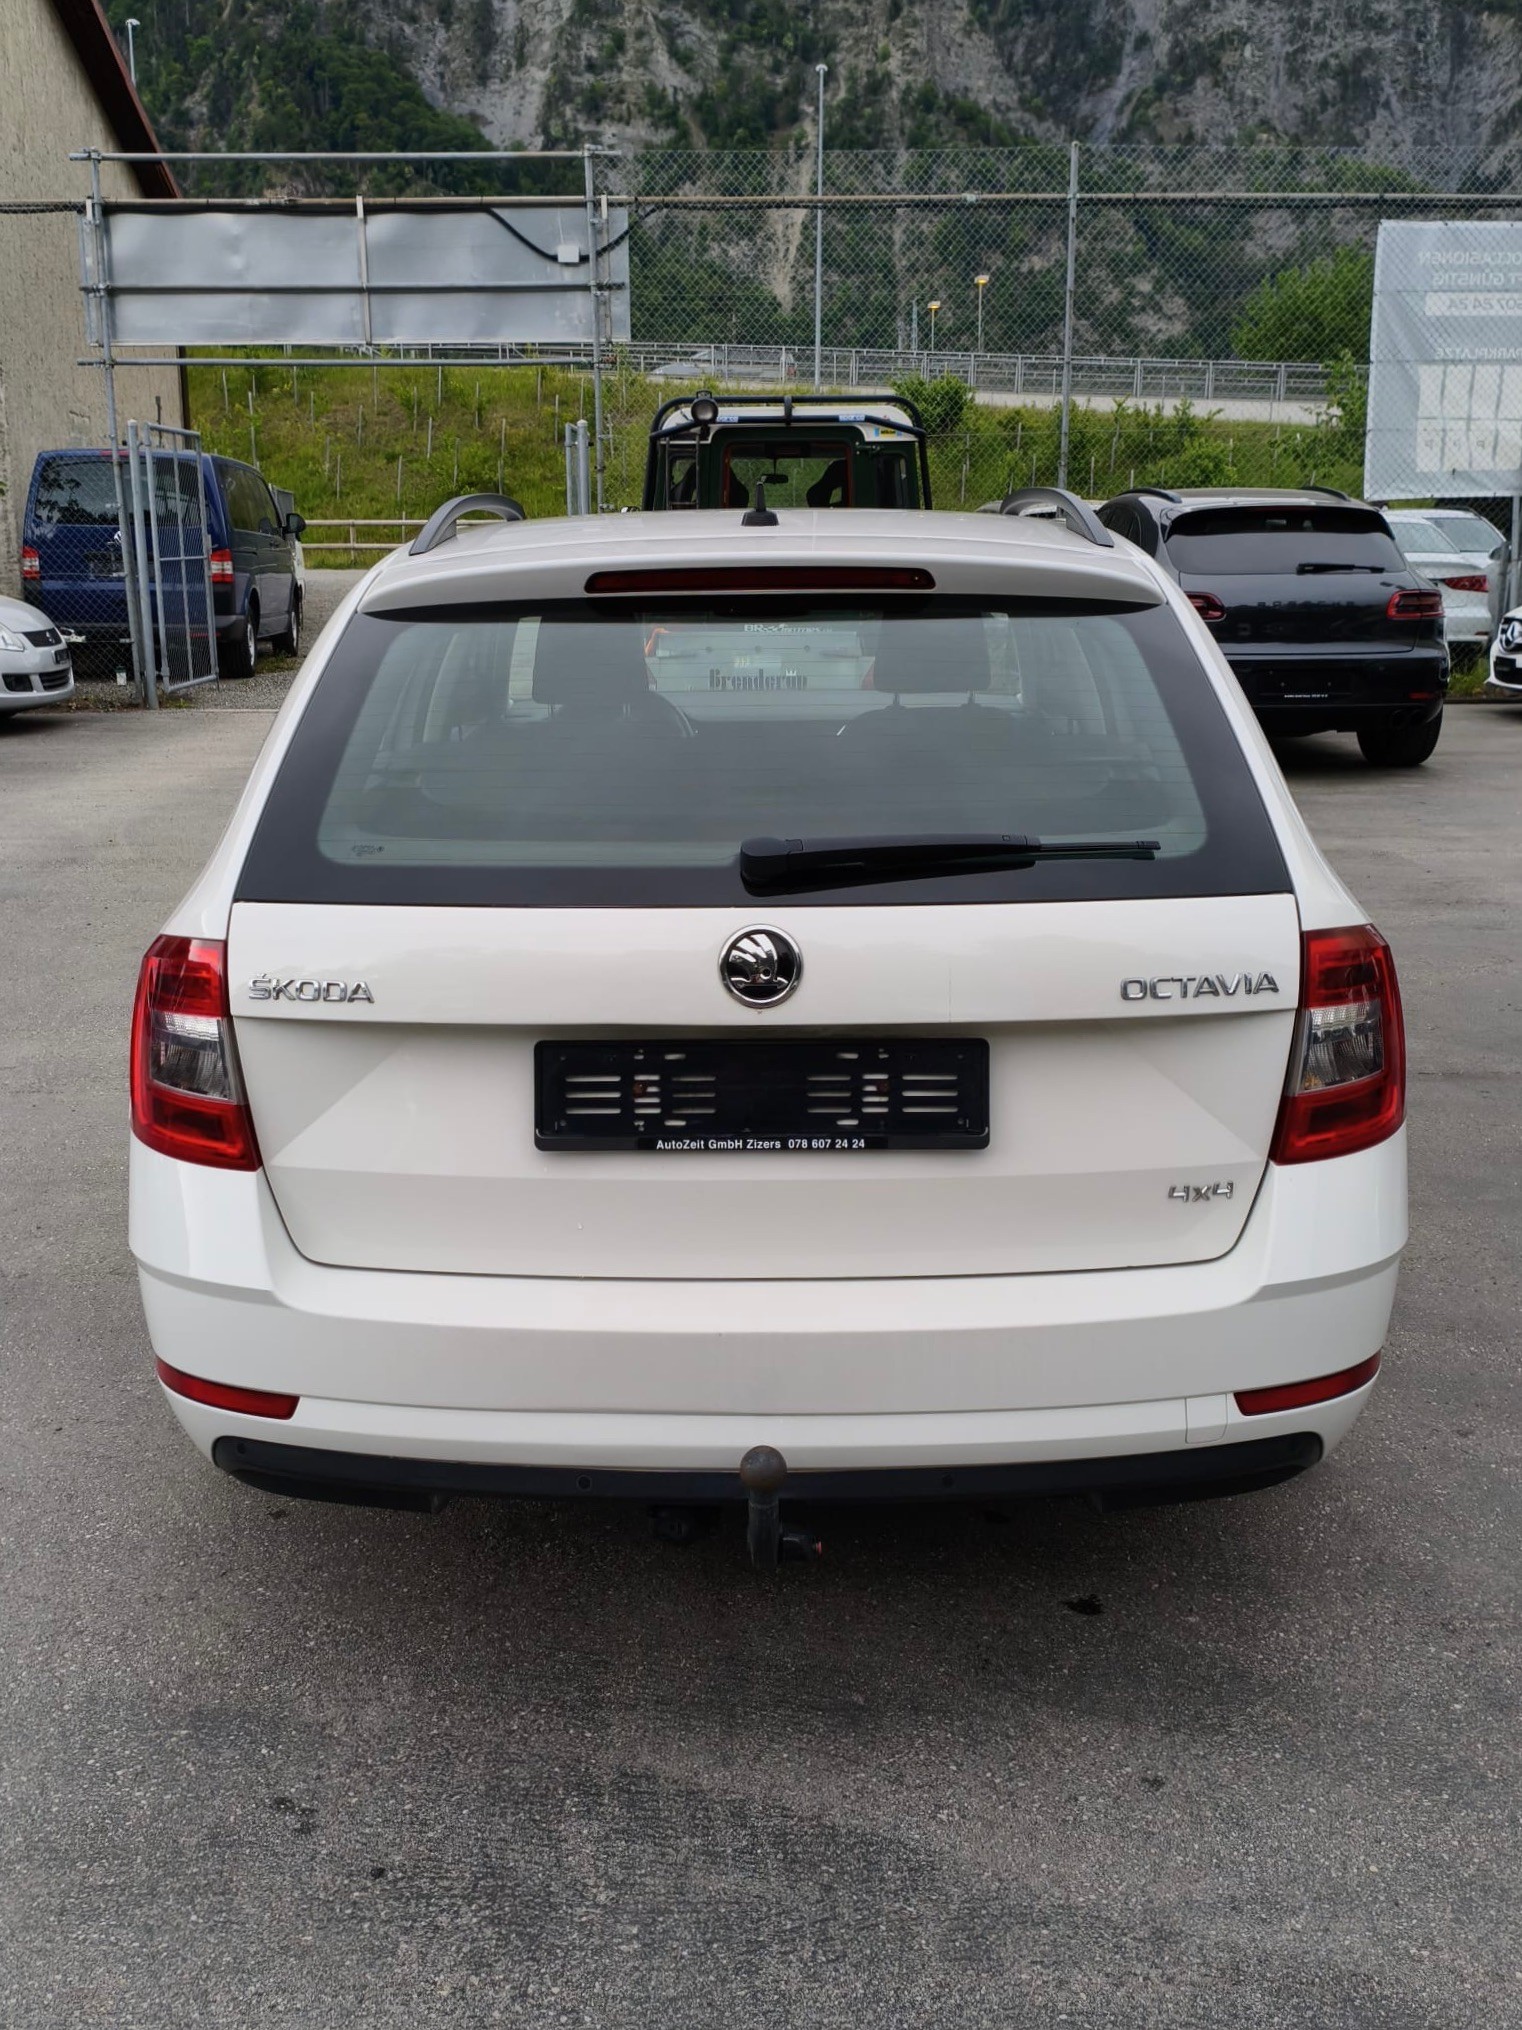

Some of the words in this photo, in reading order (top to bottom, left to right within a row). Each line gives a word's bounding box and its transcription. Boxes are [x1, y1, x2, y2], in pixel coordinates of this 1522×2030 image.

[249, 973, 375, 1003] ŠKODA
[1120, 971, 1280, 1001] OCTAVIA
[656, 1139, 704, 1150] AutoZeit
[708, 1139, 743, 1150] GmbH
[746, 1139, 781, 1149] Zizers
[788, 1139, 808, 1149] 078
[812, 1139, 831, 1149] 607
[835, 1139, 848, 1149] 24
[852, 1139, 865, 1149] 24
[1168, 1181, 1234, 1203] 4x4
